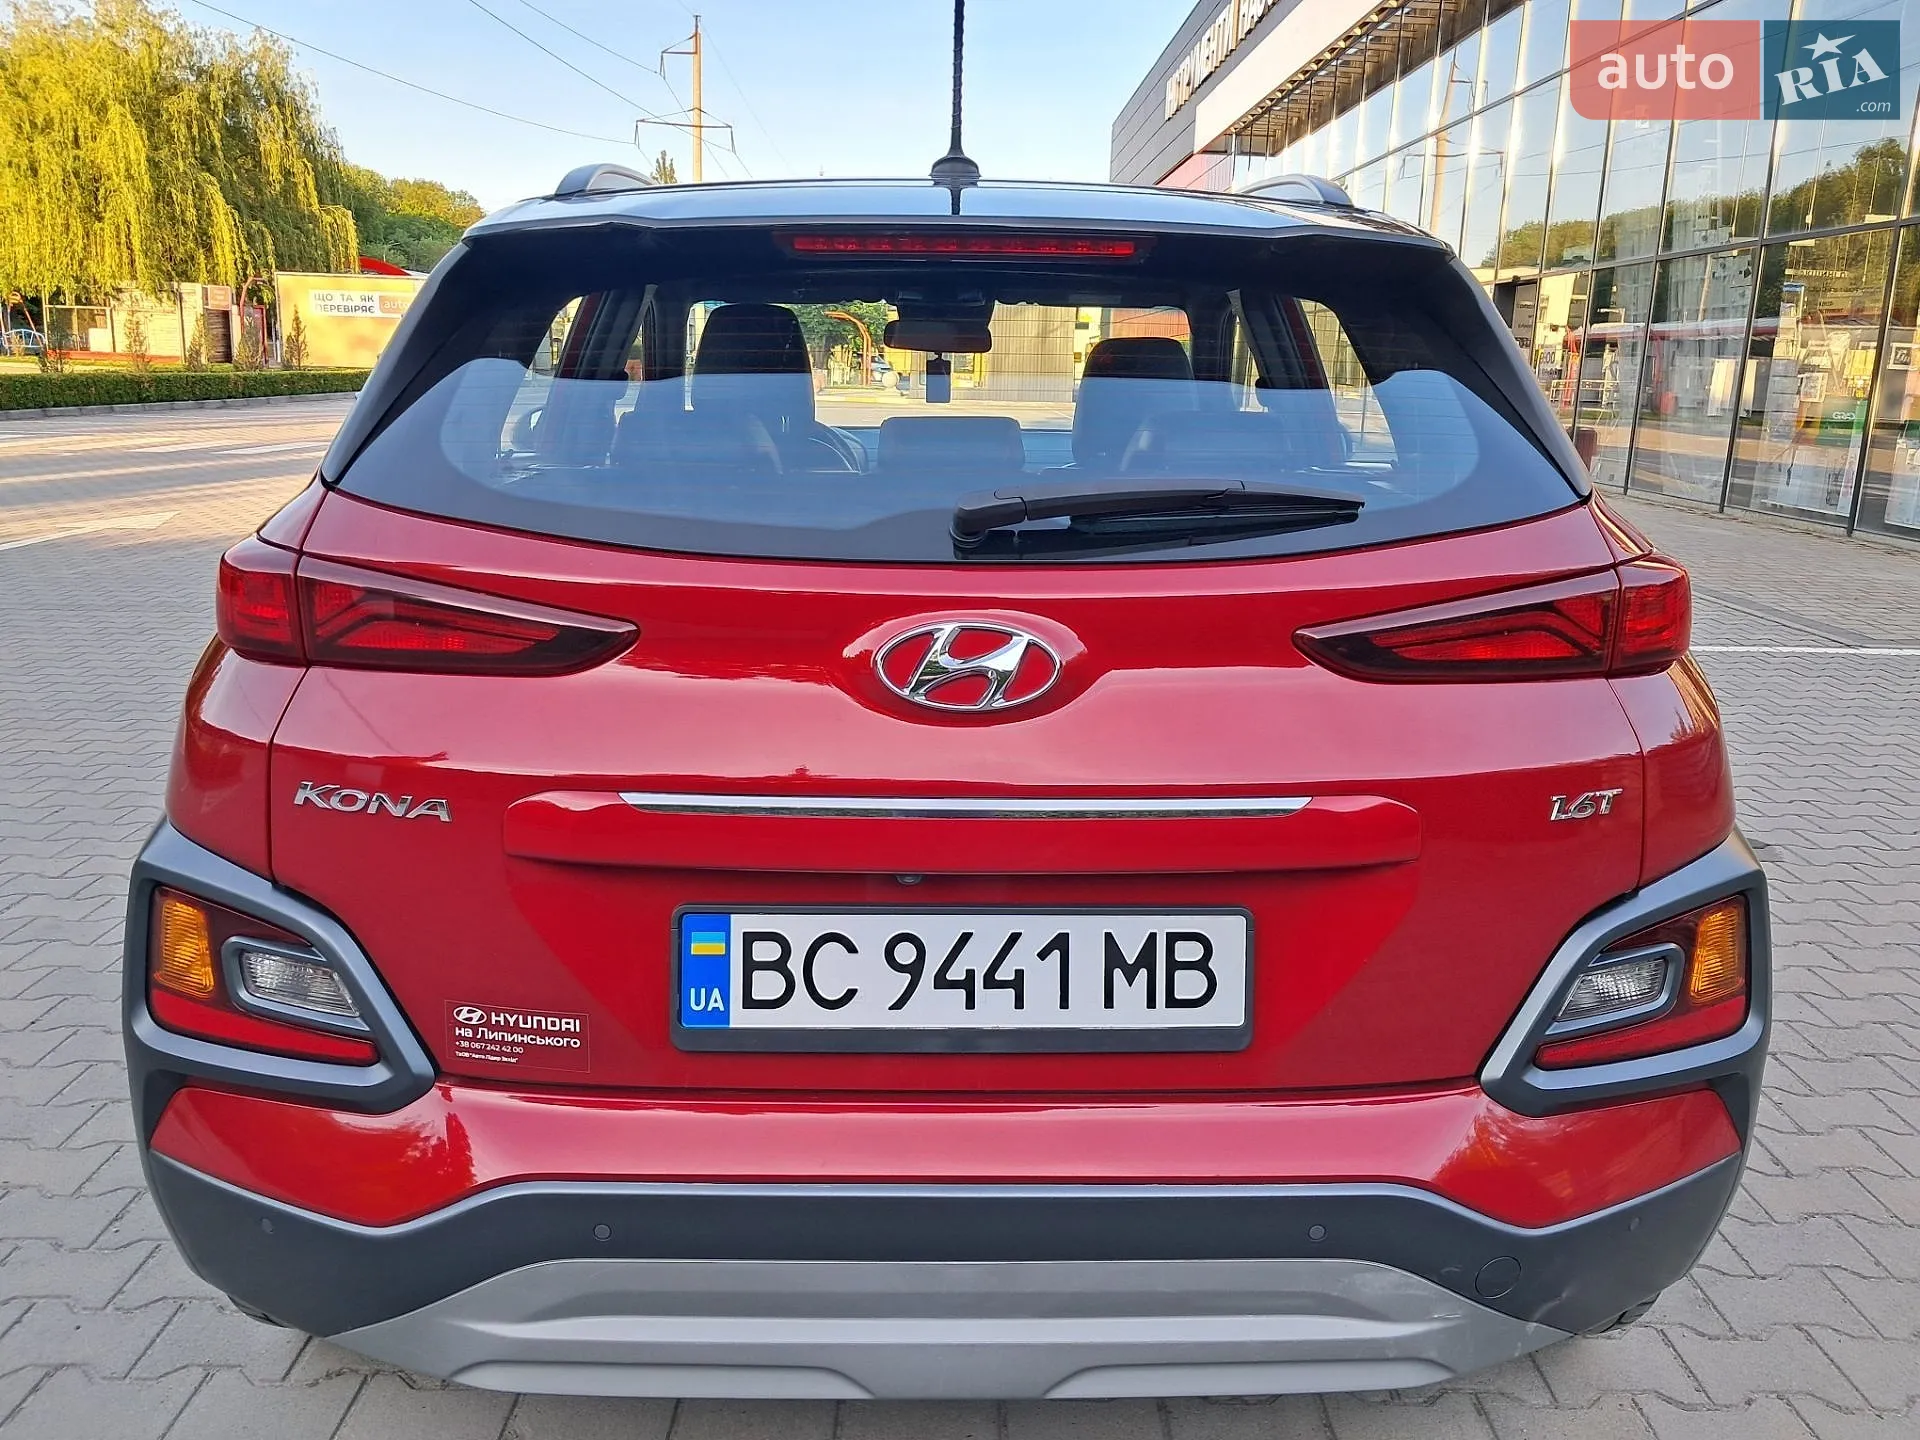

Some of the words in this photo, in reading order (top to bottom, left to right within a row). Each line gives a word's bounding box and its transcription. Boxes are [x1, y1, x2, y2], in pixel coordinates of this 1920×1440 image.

[314, 293, 333, 303] ЩО
[340, 294, 354, 302] ТА
[360, 294, 374, 302] ЯК
[315, 304, 375, 313] ПЕРЕВІРЯЄ
[293, 781, 452, 822] KONA
[741, 930, 859, 1010] BC
[883, 930, 1071, 1010] 9441
[1102, 930, 1218, 1010] MB
[689, 988, 725, 1012] UA
[491, 1011, 581, 1033] HYUNDAI
[455, 1027, 473, 1038] на
[476, 1027, 581, 1048] Липинського
[455, 1040, 470, 1048] +38
[502, 1045, 512, 1053] 42
[512, 1046, 524, 1054] 00
